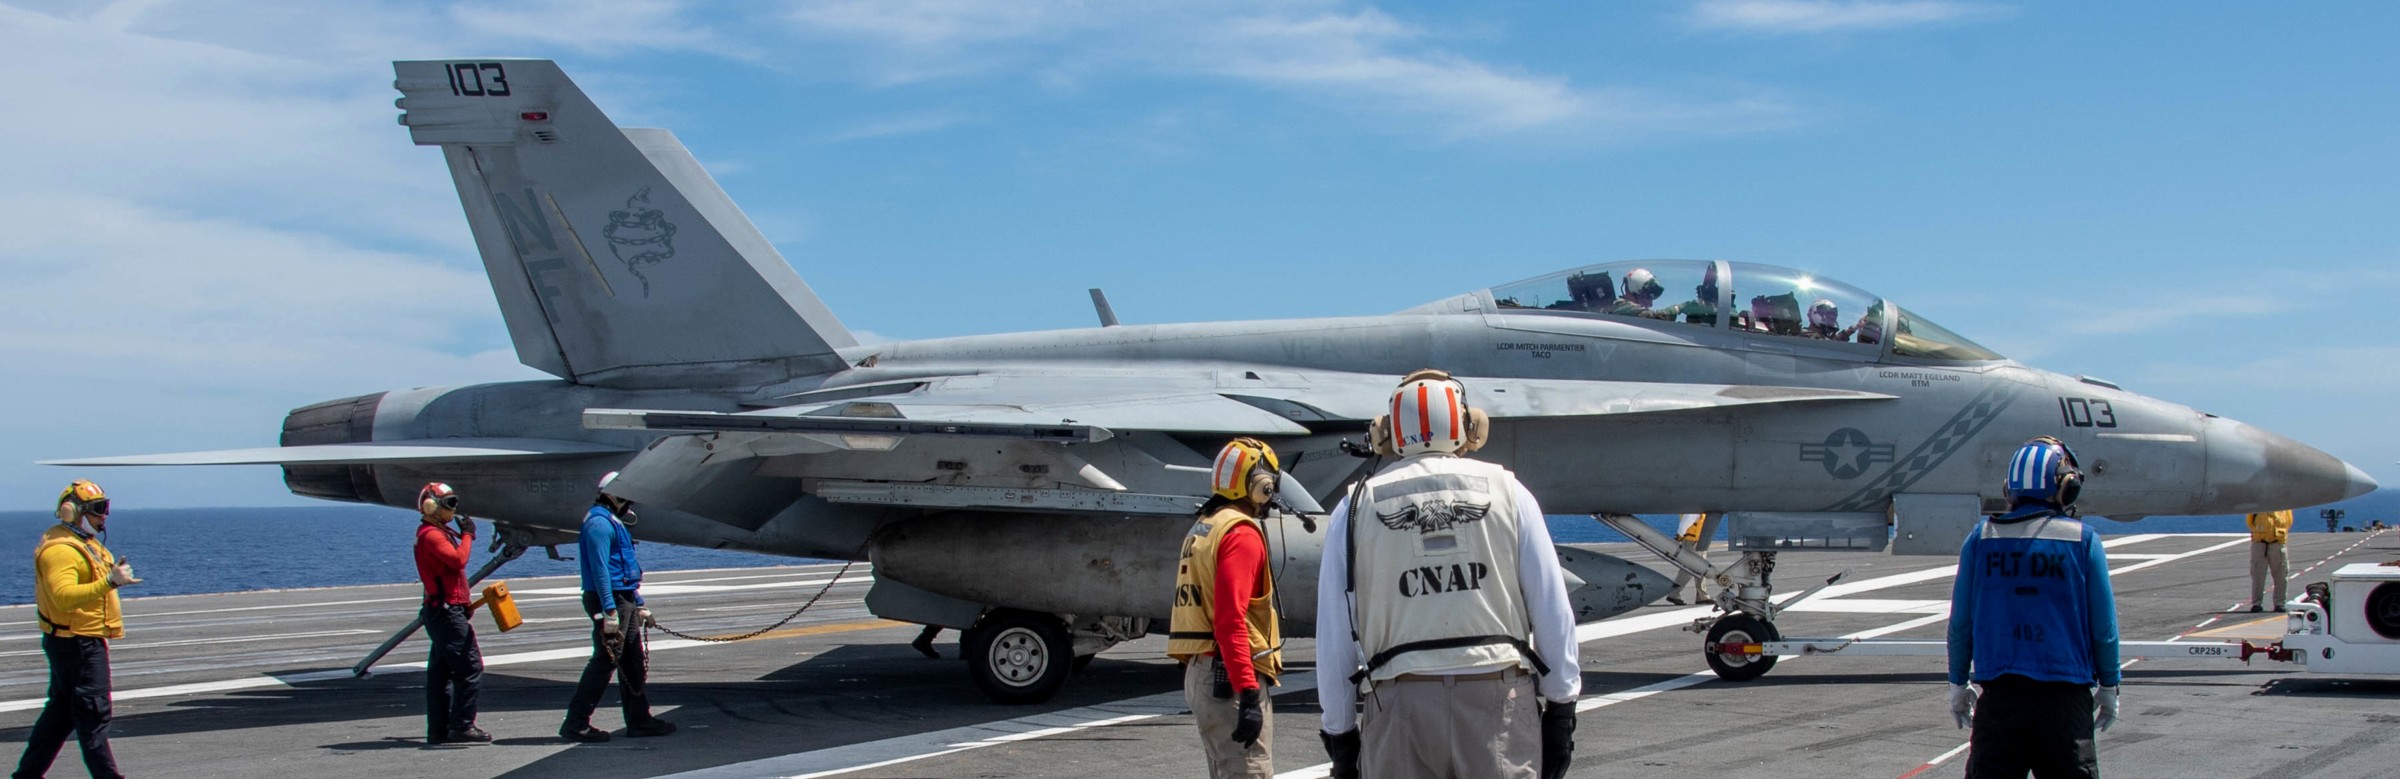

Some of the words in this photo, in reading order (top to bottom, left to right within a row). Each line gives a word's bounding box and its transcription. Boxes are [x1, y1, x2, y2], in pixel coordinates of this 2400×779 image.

[445, 63, 511, 96] 103
[495, 188, 558, 255] N
[526, 257, 567, 324] F
[1496, 343, 1514, 351] LCDR
[1515, 343, 1538, 352] MITCH
[1540, 344, 1585, 352] PARMENTIER
[1531, 351, 1551, 359] TACO
[1879, 371, 1899, 379] LCDR
[1901, 372, 1922, 380] MATT
[1925, 373, 1960, 382] EGELAND
[1912, 380, 1930, 388] BTM
[2058, 397, 2117, 428] 103
[1402, 432, 1434, 446] CNAP
[1986, 551, 2024, 577] FLT
[2031, 552, 2066, 580] DK
[1398, 562, 1488, 598] CNAP
[2188, 646, 2222, 655] CRP258
